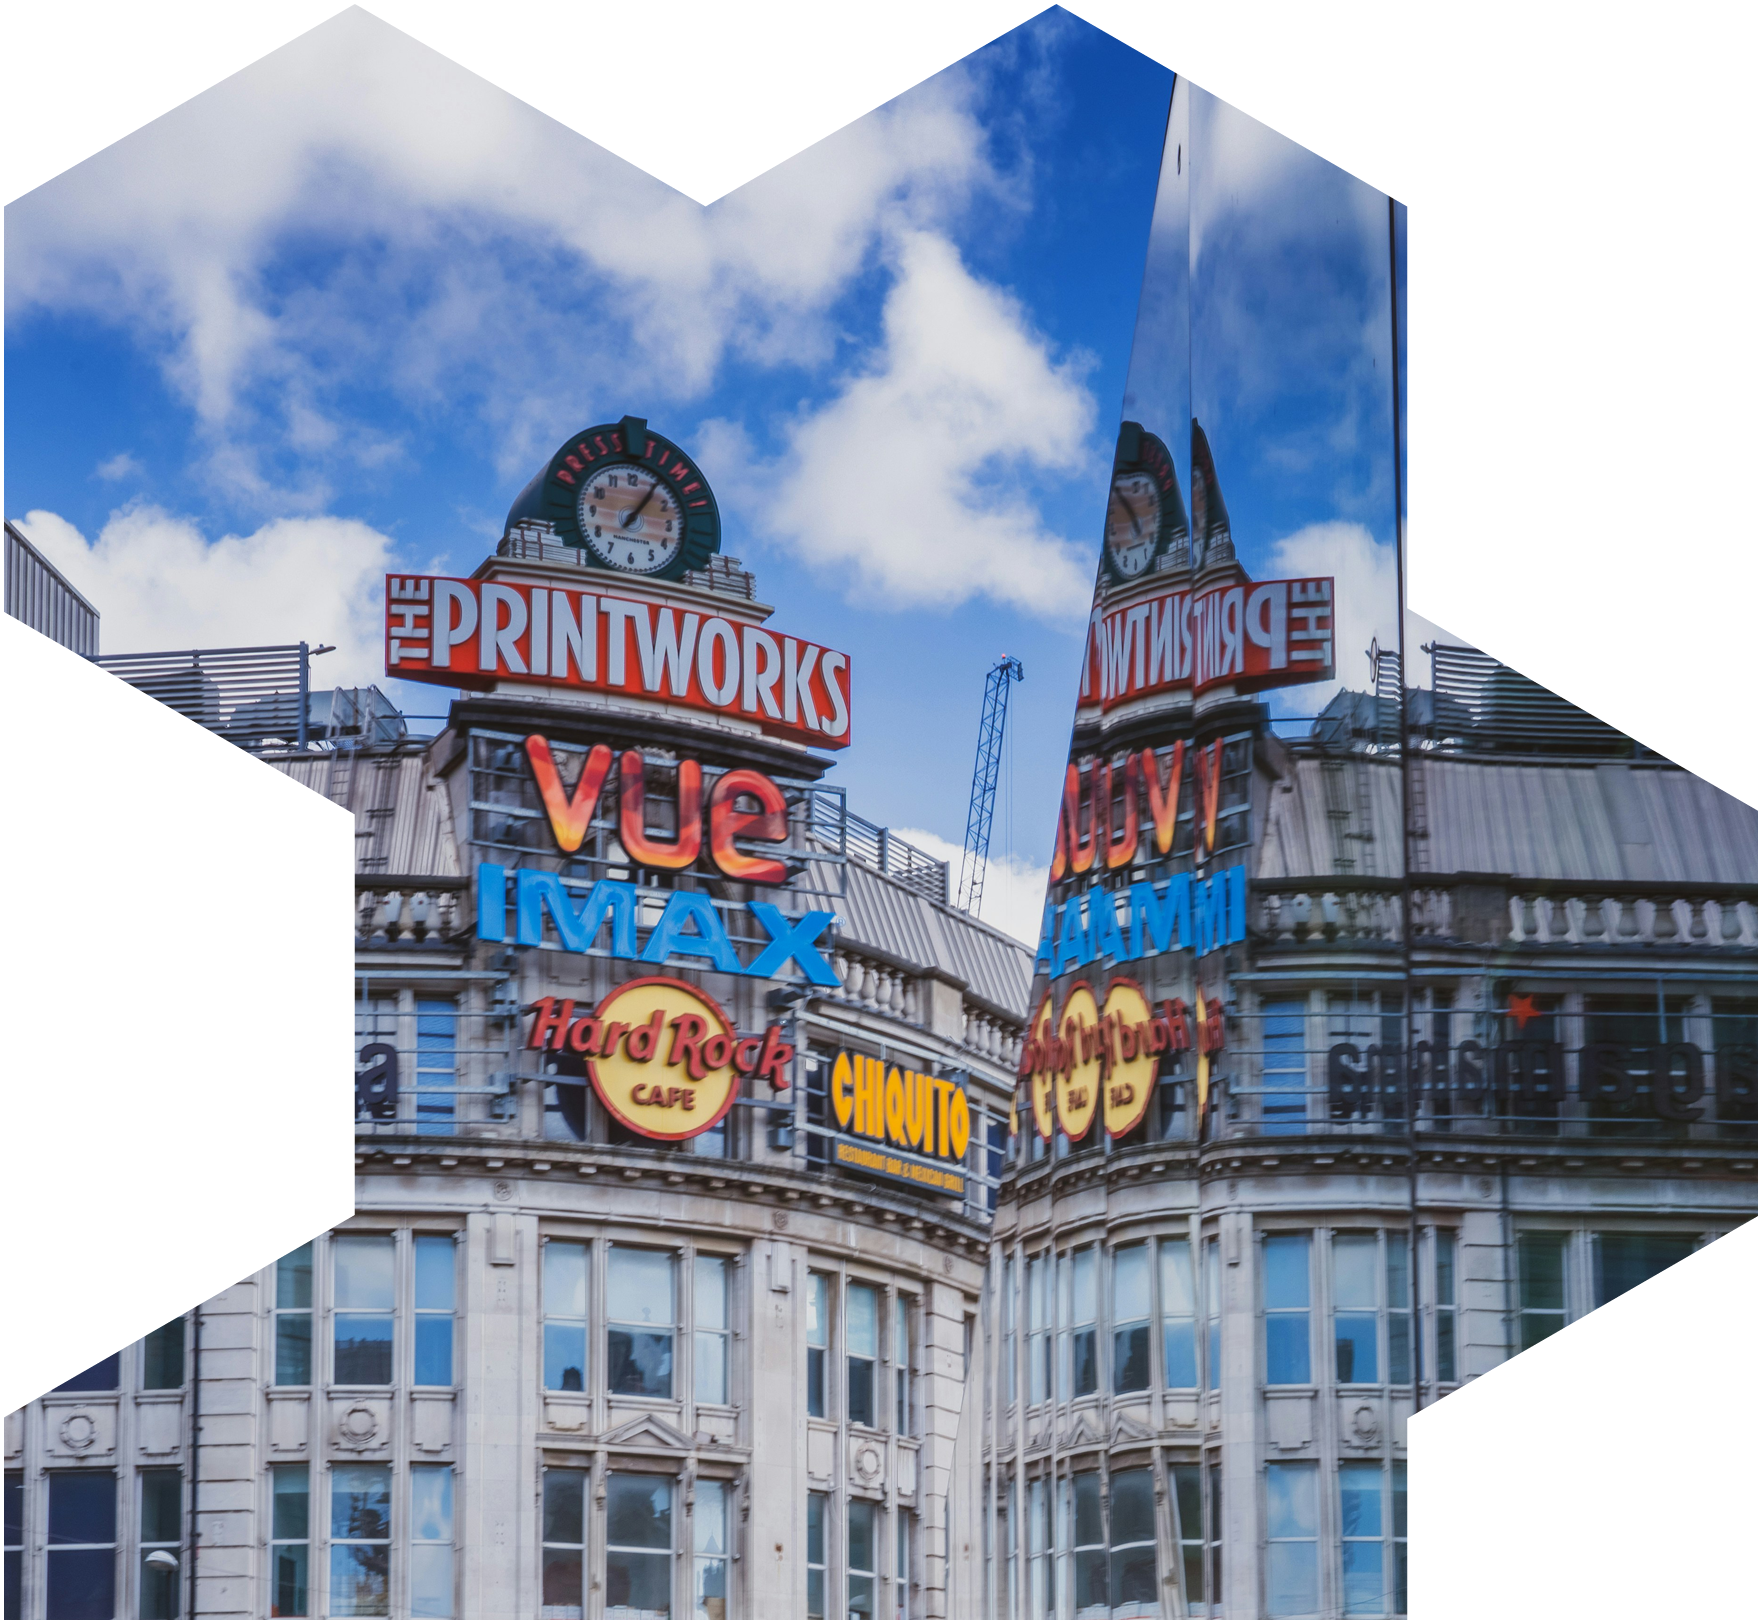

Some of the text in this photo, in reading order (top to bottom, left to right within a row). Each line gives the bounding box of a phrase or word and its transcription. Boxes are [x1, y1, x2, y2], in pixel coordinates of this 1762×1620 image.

[556, 433, 708, 508] PRESS TIME!
[608, 474, 618, 488] 11
[626, 472, 639, 487] 12
[593, 486, 606, 500] 10
[589, 504, 597, 518] 9
[660, 499, 669, 513] 2
[594, 524, 602, 538] 8
[664, 519, 673, 533] 3
[613, 534, 650, 546] MANCHESTER
[660, 537, 668, 550] 4
[607, 541, 615, 554] 7
[627, 552, 635, 565] 6
[647, 549, 655, 562] 5
[390, 578, 849, 737] THE PRINTWORKS
[477, 862, 842, 987] IMAX
[527, 995, 795, 1091] Hard Rock
[632, 1083, 696, 1110] CAFE
[832, 1051, 970, 1160] CHIQUITO
